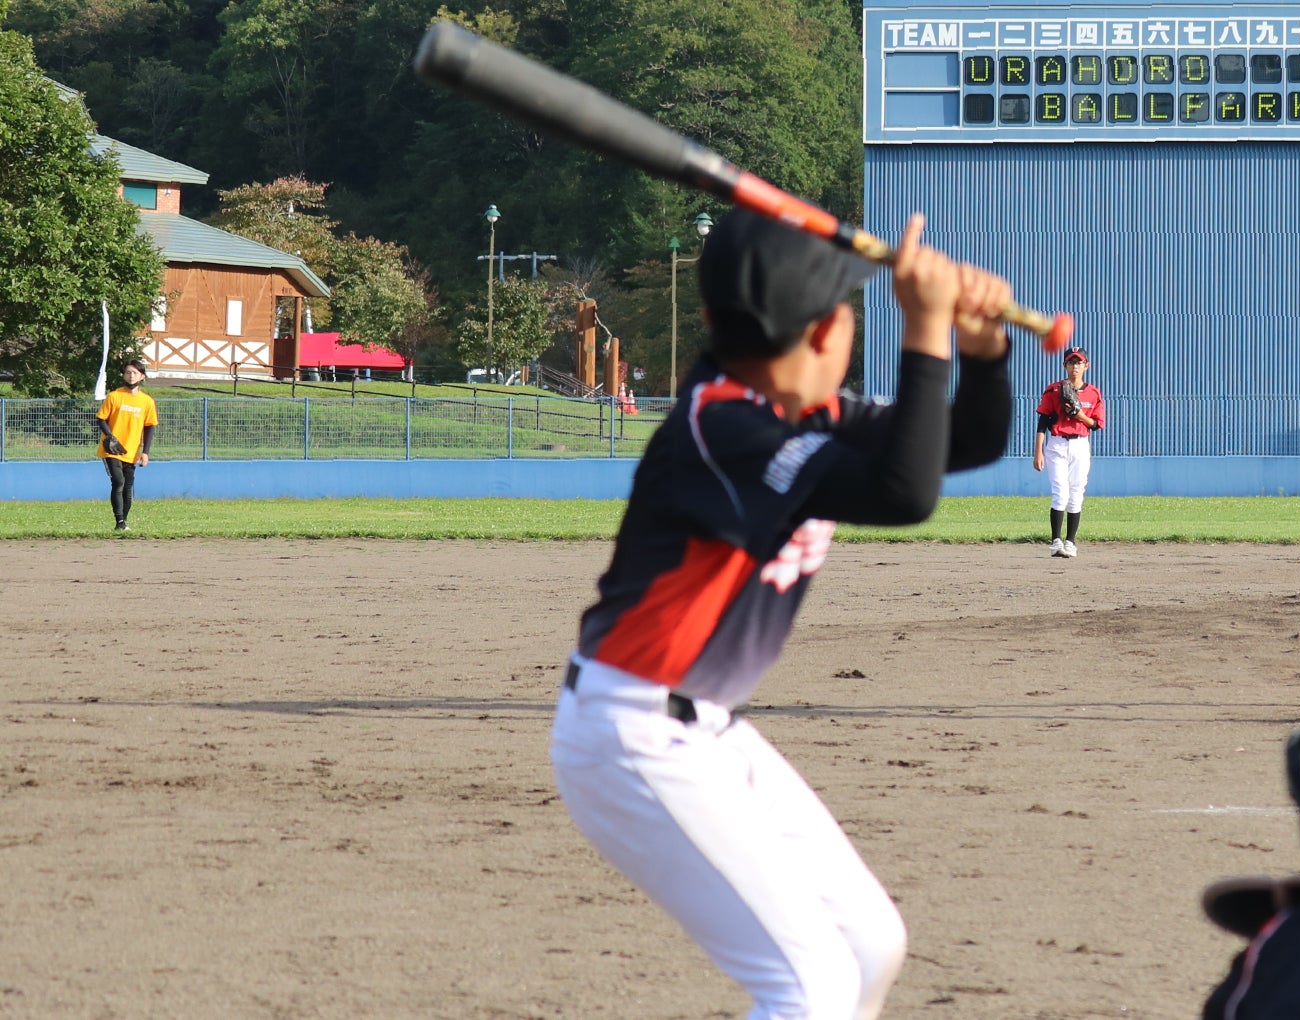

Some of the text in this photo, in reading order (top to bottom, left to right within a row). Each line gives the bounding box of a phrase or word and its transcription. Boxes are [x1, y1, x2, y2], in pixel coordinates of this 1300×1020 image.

[887, 23, 957, 46] TEAM
[1004, 25, 1026, 44] 二
[1040, 24, 1062, 44] 三
[1076, 23, 1098, 44] 四
[1112, 23, 1134, 44] 五
[1148, 22, 1170, 44] 六
[1184, 22, 1206, 44] 七
[1219, 21, 1242, 44] 八
[1256, 21, 1278, 44] 九
[971, 57, 1204, 82] URAHORO
